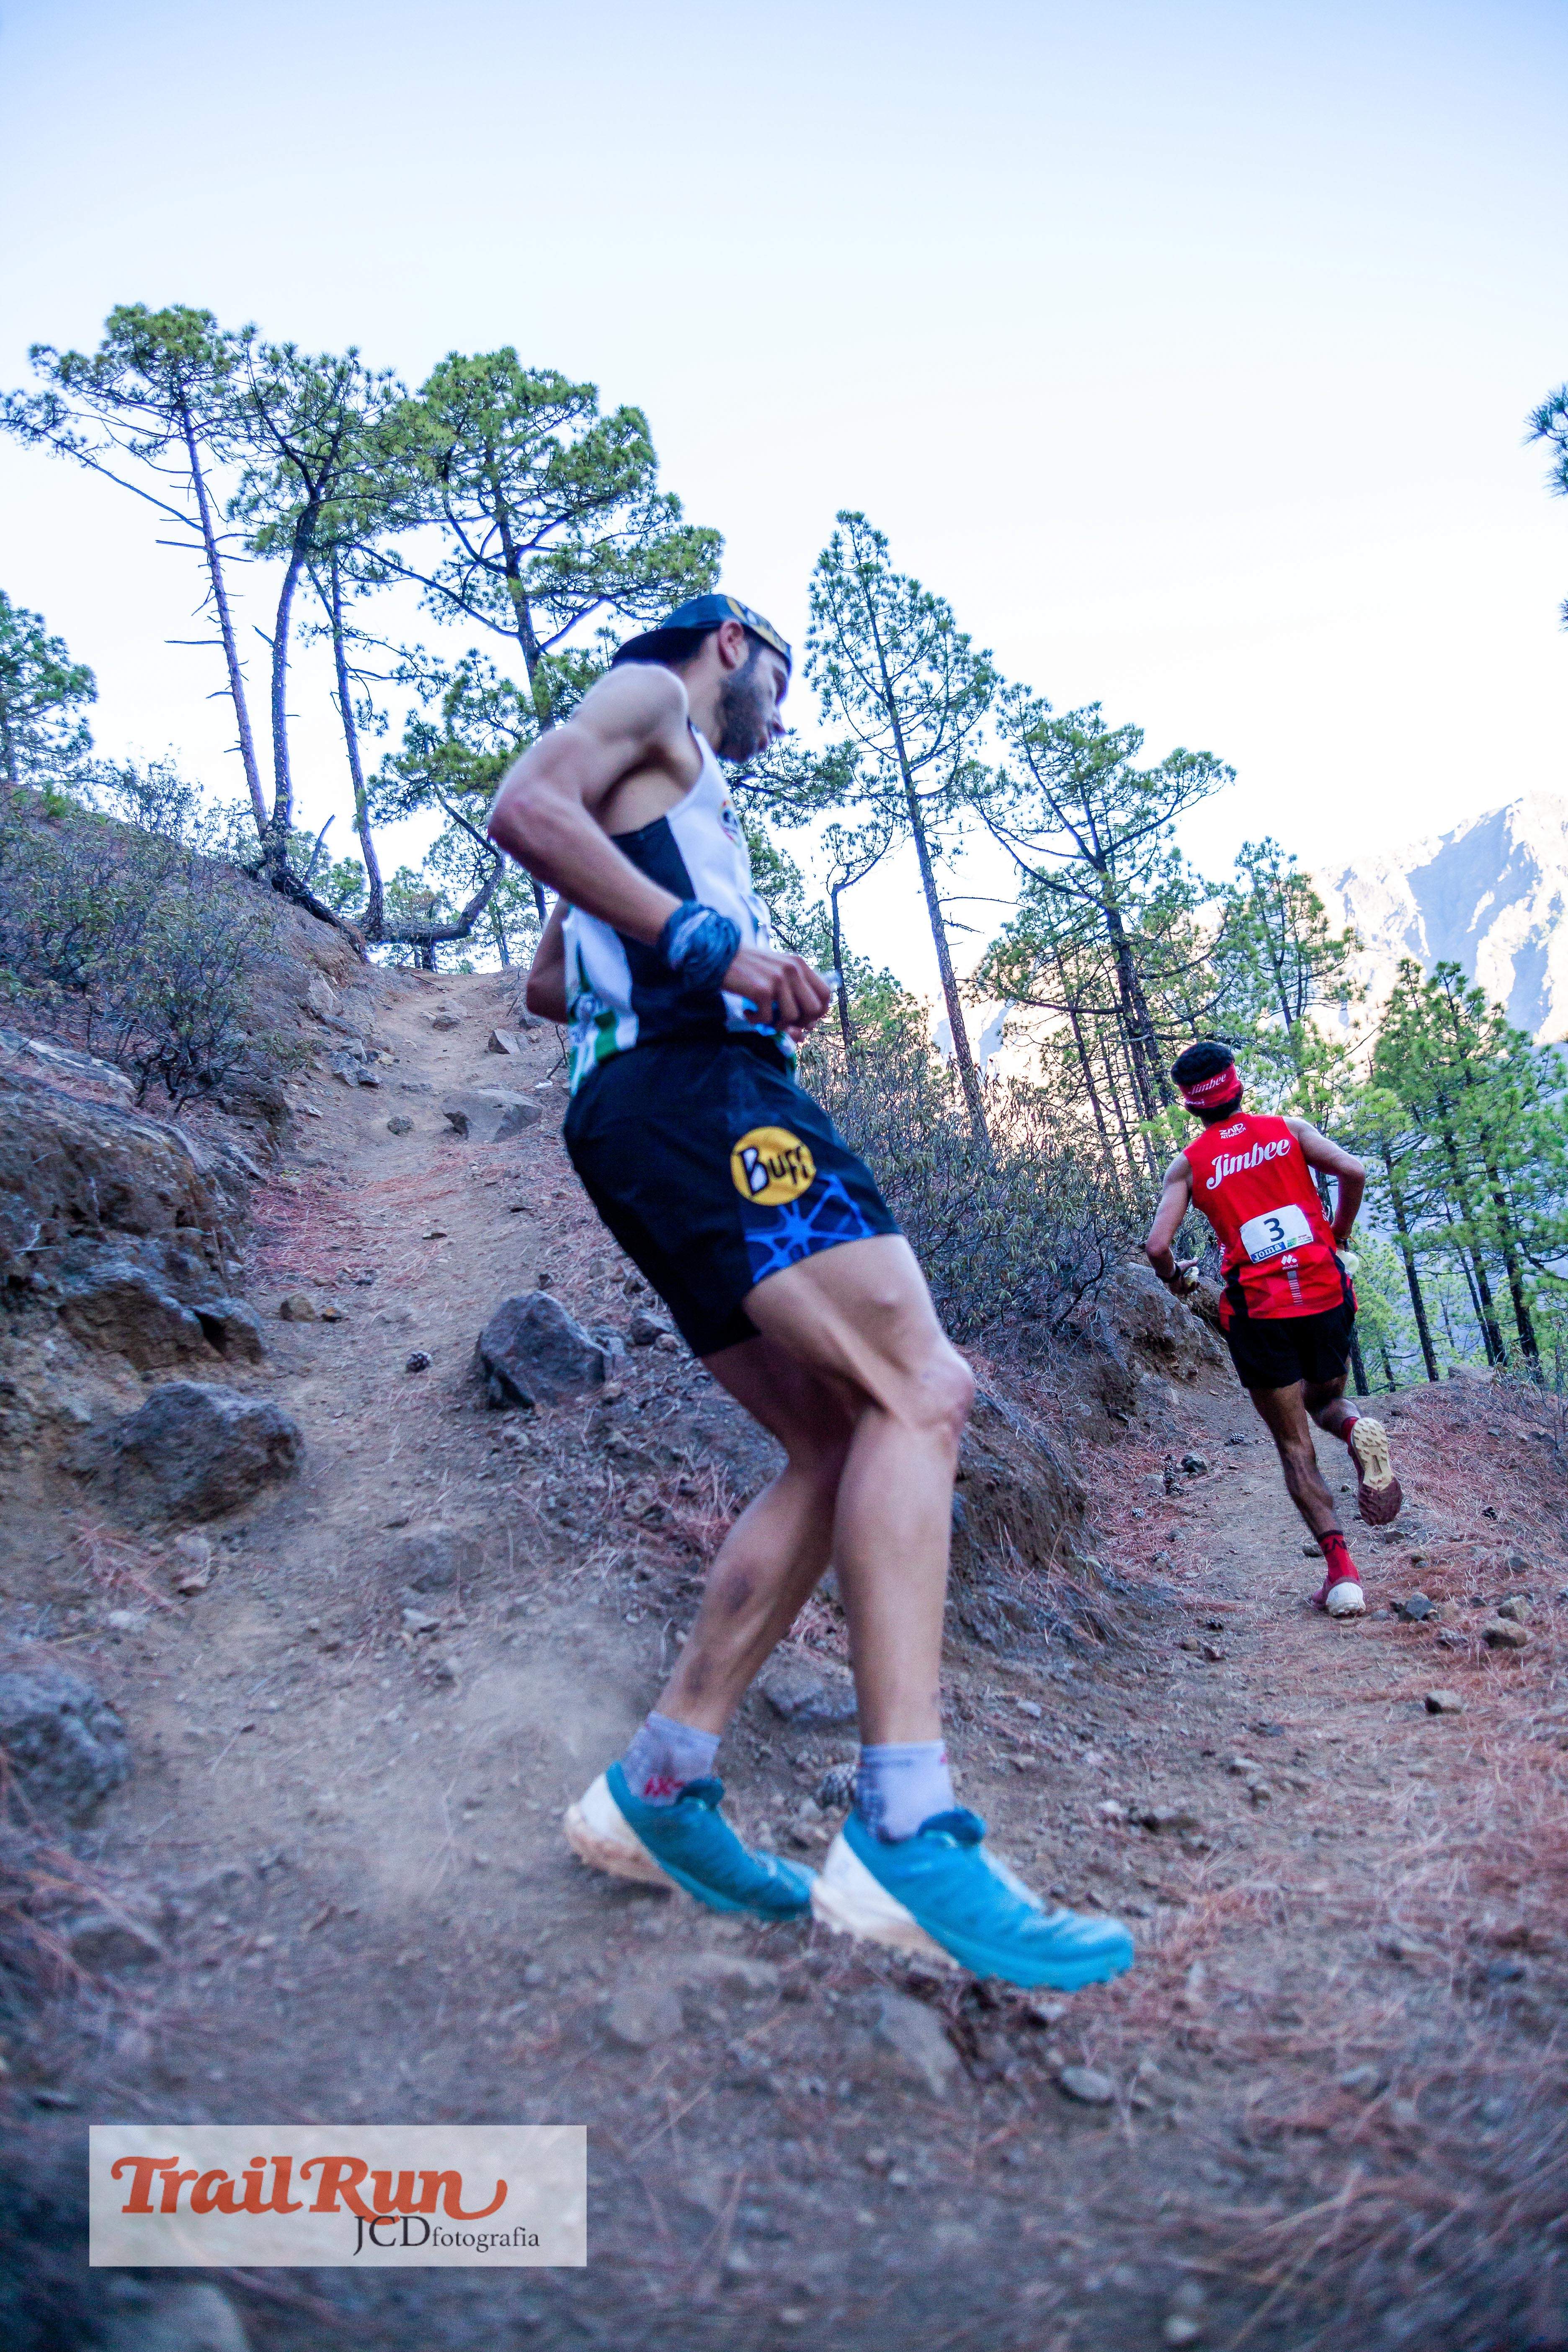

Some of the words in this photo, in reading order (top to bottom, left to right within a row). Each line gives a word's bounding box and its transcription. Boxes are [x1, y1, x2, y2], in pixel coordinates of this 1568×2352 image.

[1188, 1074, 1227, 1095] Jimbee
[1206, 1139, 1290, 1189] Jimbee
[1263, 1217, 1285, 1242] 3
